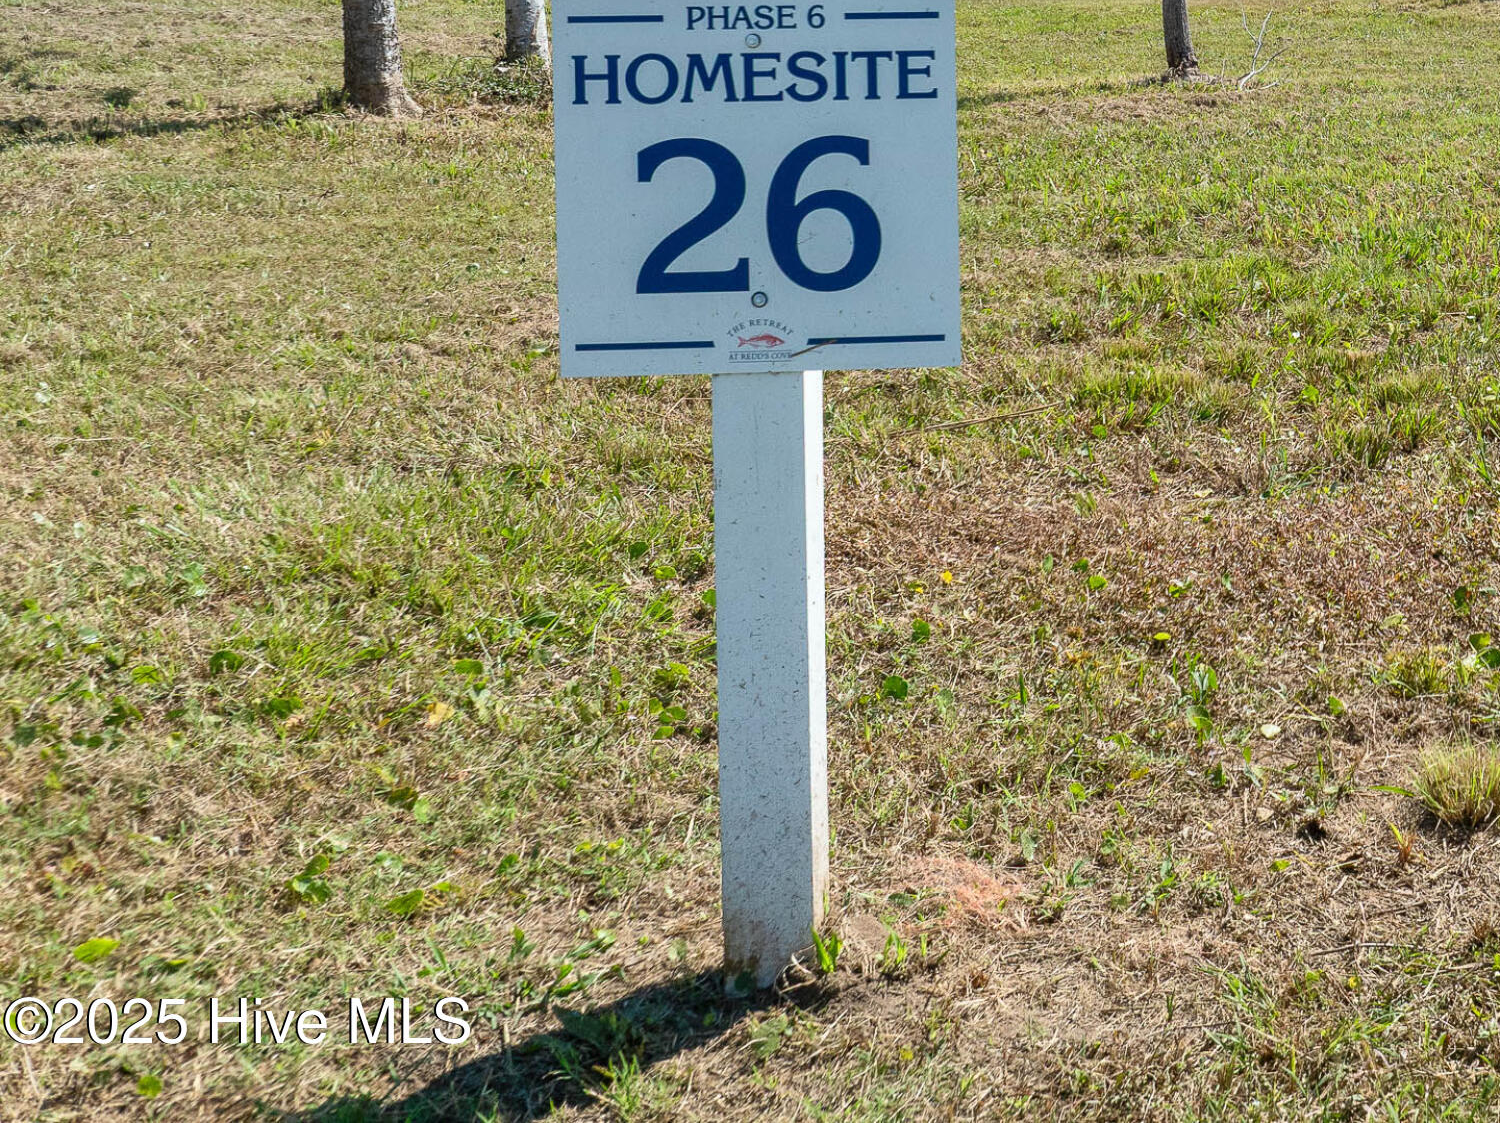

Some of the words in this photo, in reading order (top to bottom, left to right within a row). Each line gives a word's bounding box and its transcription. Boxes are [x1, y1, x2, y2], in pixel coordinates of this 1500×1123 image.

[686, 5, 796, 30] PHASE
[807, 5, 826, 29] 6
[571, 50, 938, 105] HOMESITE
[636, 135, 882, 294] 26
[727, 323, 745, 337] THE
[749, 319, 794, 336] RETREAT
